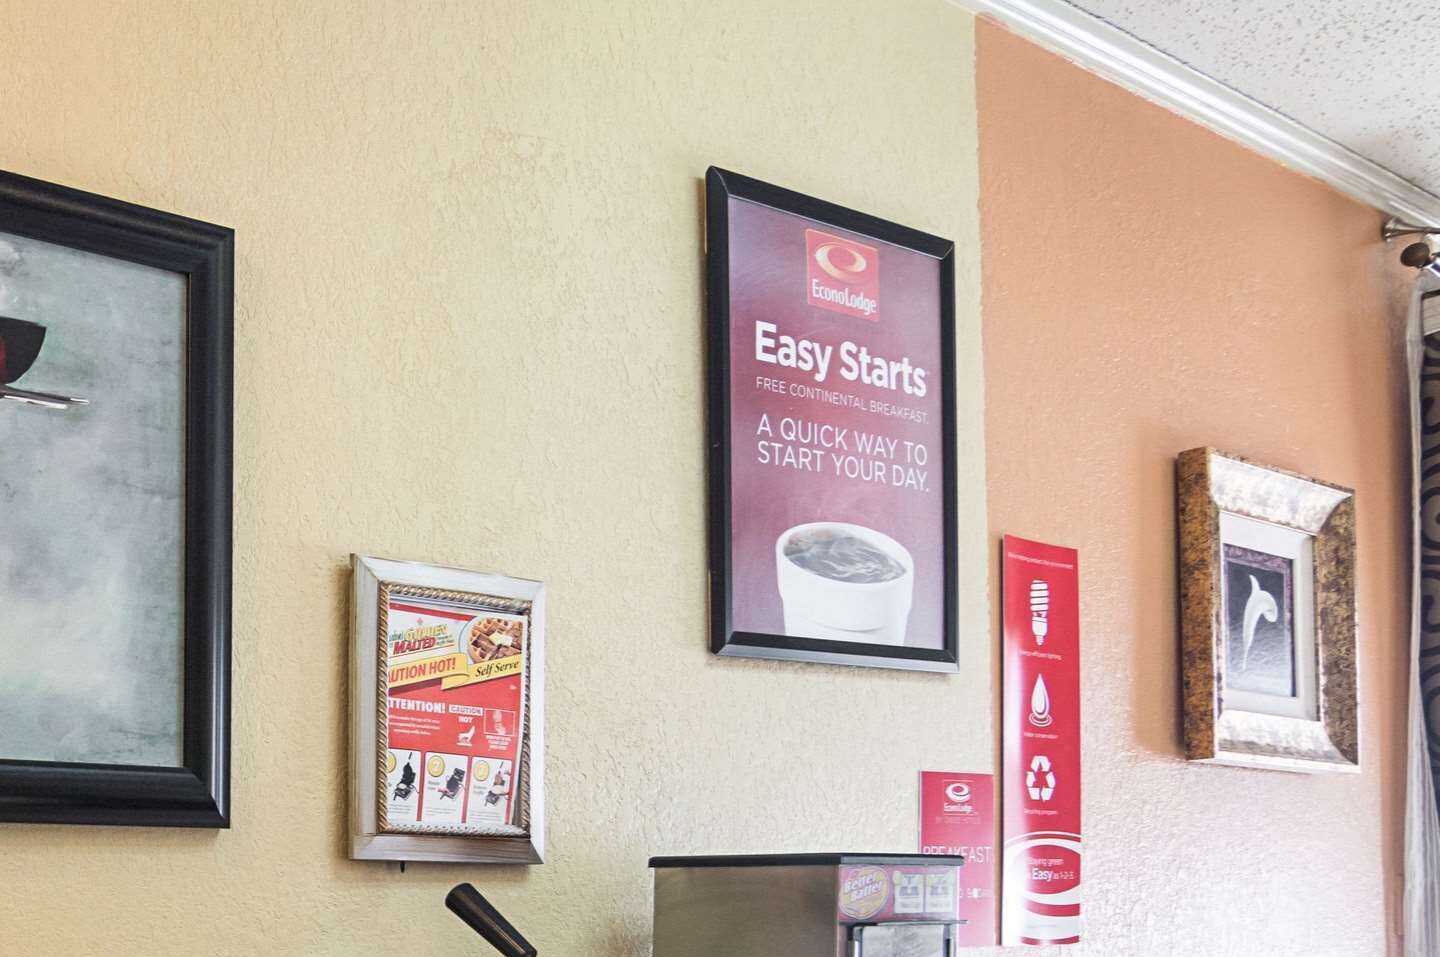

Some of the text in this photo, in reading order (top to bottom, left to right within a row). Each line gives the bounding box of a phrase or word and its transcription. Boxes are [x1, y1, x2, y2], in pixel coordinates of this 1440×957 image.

[812, 279, 877, 316] EconoLodge
[755, 320, 927, 398] Easy Starts
[756, 376, 787, 394] FREE
[789, 383, 867, 411] CONTINENTAL
[757, 413, 928, 466] A QUICK WAY TO
[757, 440, 930, 492] START YOUR DAY.
[392, 636, 436, 655] MALTED
[429, 657, 457, 675] HOT!
[475, 661, 519, 677] Self Serve
[1032, 868, 1053, 882] Easy
